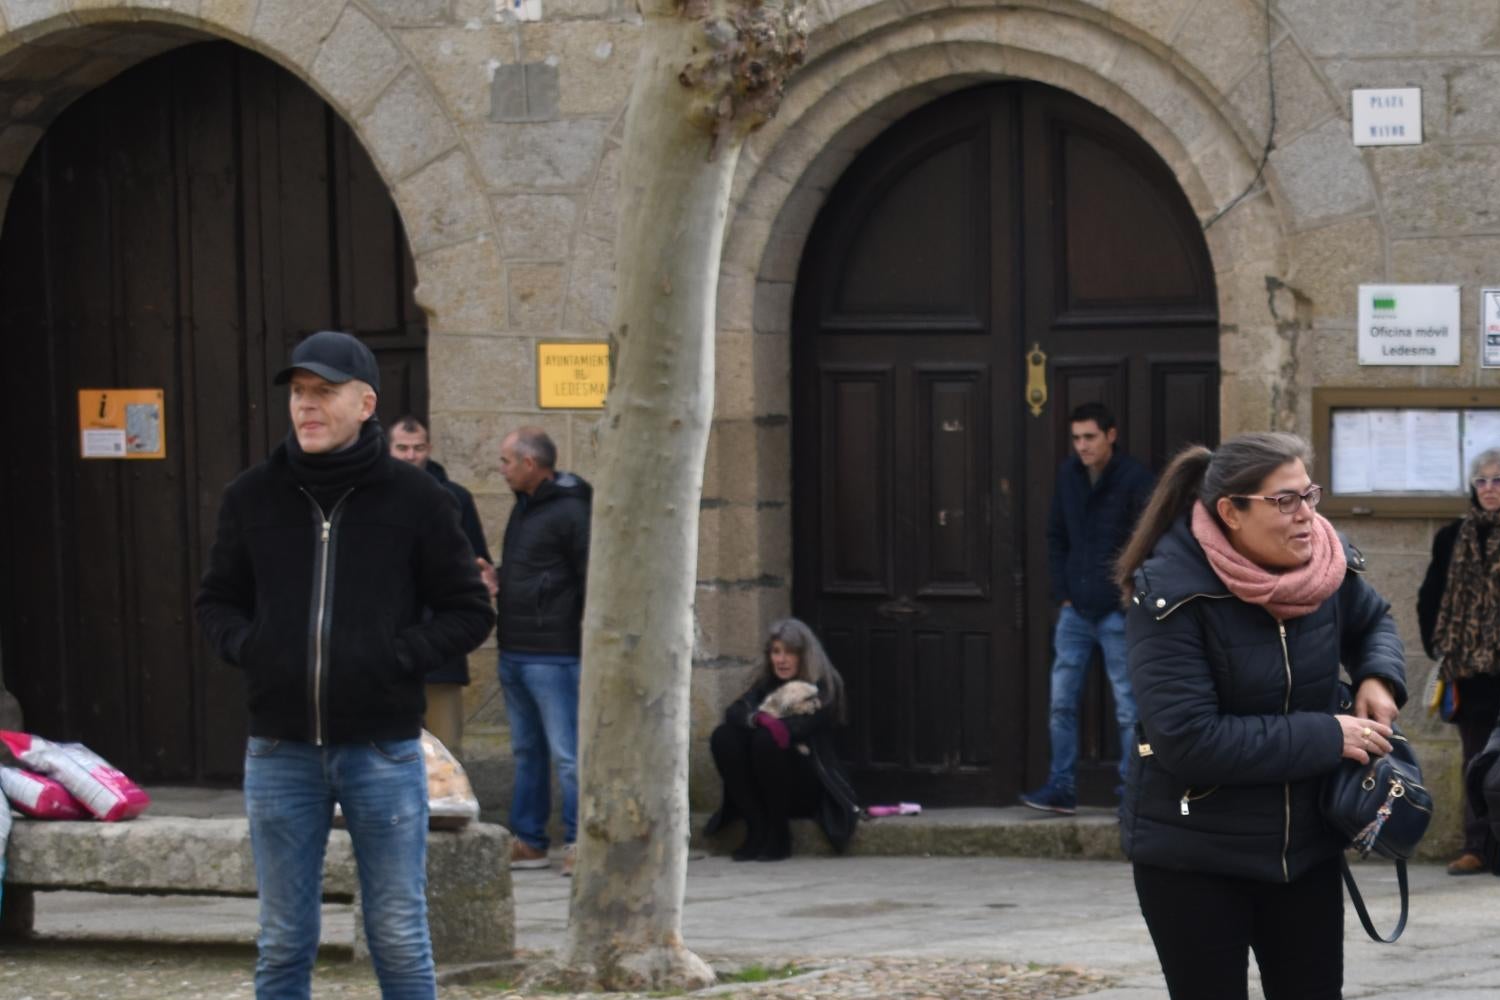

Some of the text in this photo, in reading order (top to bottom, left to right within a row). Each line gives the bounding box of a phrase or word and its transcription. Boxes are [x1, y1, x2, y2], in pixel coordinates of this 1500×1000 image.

[1370, 96, 1404, 108] PLAZA
[1370, 125, 1405, 137] MAYOR
[1370, 327, 1449, 338] Oficina móvil
[1382, 345, 1436, 356] Ledesma
[545, 354, 609, 367] AYUNTAMIENT
[555, 382, 607, 397] LEDESMA
